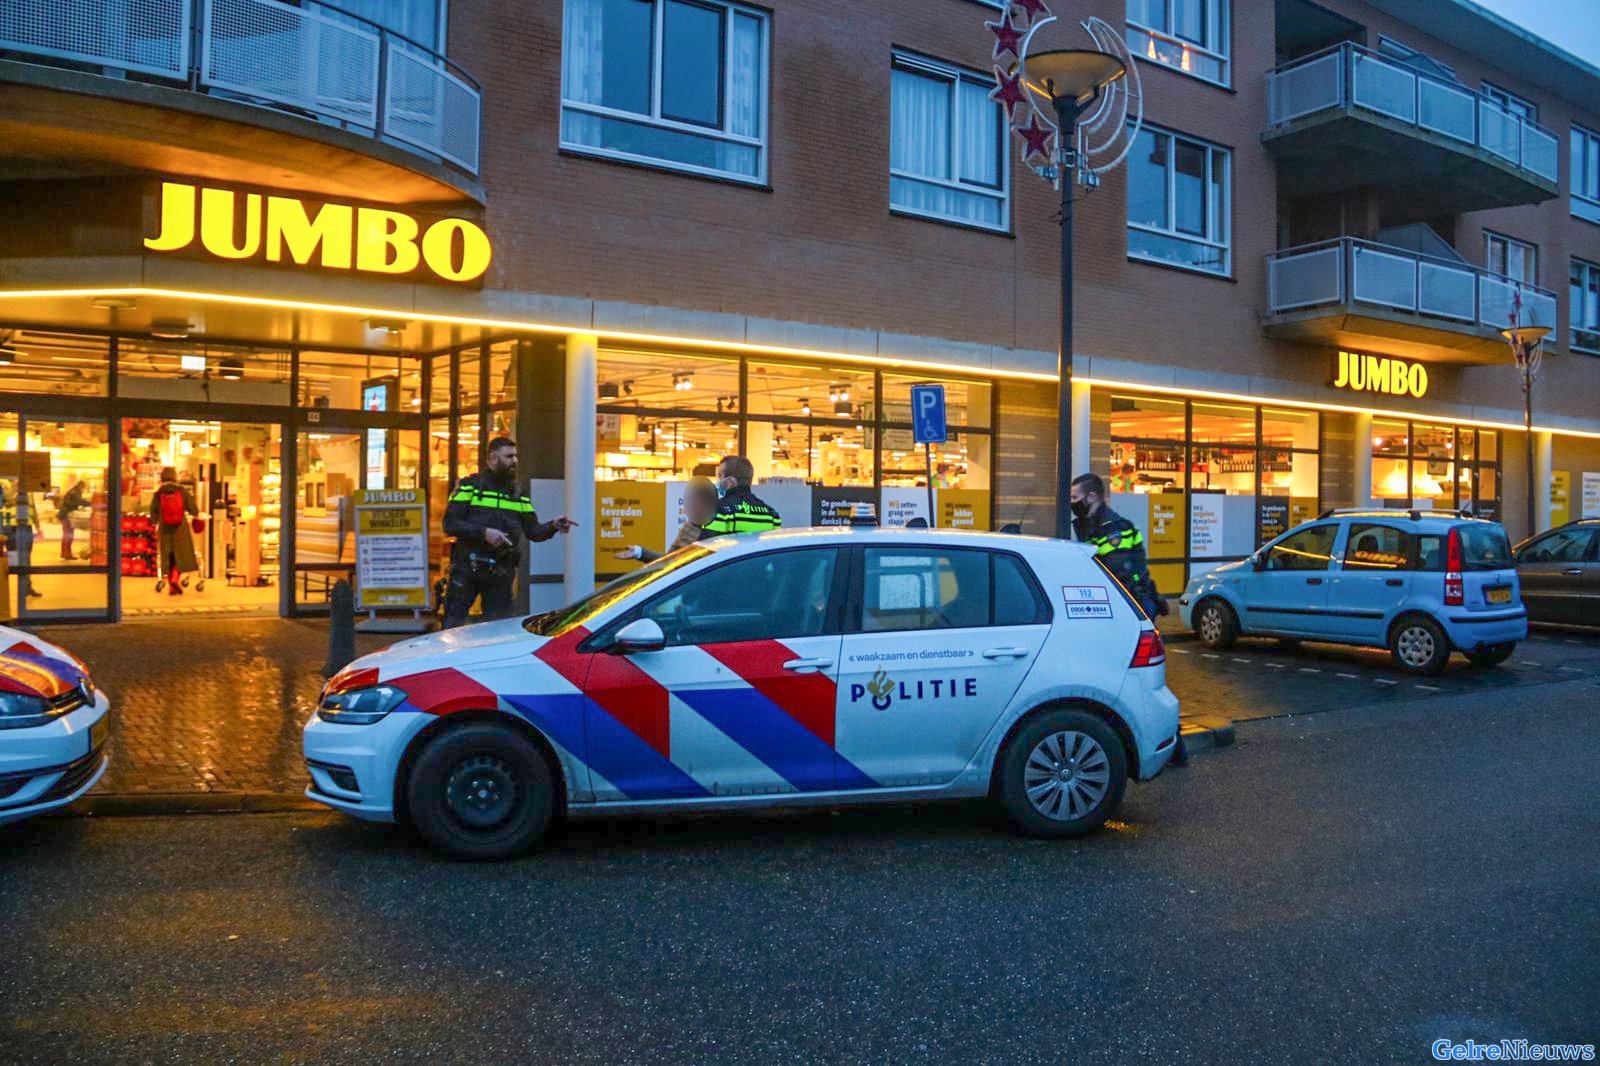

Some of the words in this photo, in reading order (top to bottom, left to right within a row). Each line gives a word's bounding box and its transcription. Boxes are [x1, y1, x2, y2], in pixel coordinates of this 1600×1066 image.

[143, 181, 492, 281] JUMBO
[1334, 351, 1428, 398] JUMBO
[920, 391, 937, 419] P
[364, 491, 416, 503] JUMBO
[601, 497, 614, 506] Wij
[888, 500, 900, 509] Wij
[601, 507, 643, 516] tevreden
[612, 517, 621, 529] jij
[601, 529, 624, 538] bent.
[1079, 589, 1093, 599] 112
[856, 652, 906, 661] waakzaam
[906, 651, 919, 660] en
[920, 648, 968, 659] dienstbaar
[851, 677, 978, 711] POLITIE
